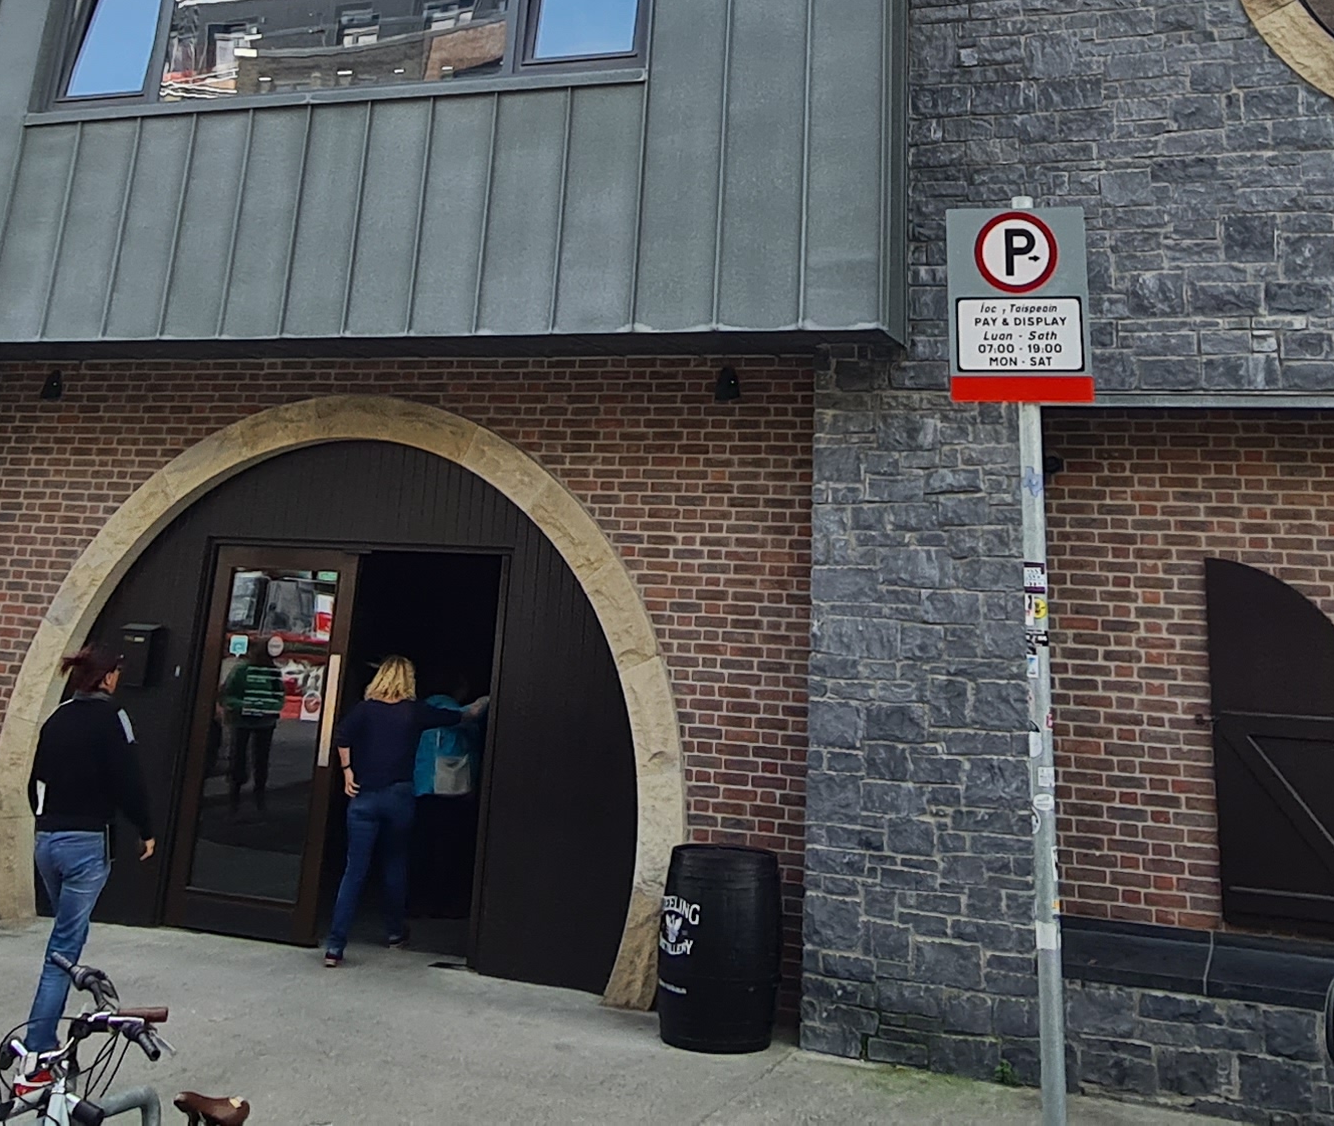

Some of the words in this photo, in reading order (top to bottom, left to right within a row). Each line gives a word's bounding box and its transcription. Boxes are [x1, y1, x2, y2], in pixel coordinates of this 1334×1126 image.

[1004, 228, 1036, 276] P
[974, 317, 998, 326] PAY
[1001, 317, 1009, 326] &
[1013, 316, 1067, 326] DISPLAY
[983, 331, 1013, 341] Luan
[1028, 330, 1058, 341] Sath
[989, 356, 1018, 367] MON
[1029, 356, 1053, 366] SAT
